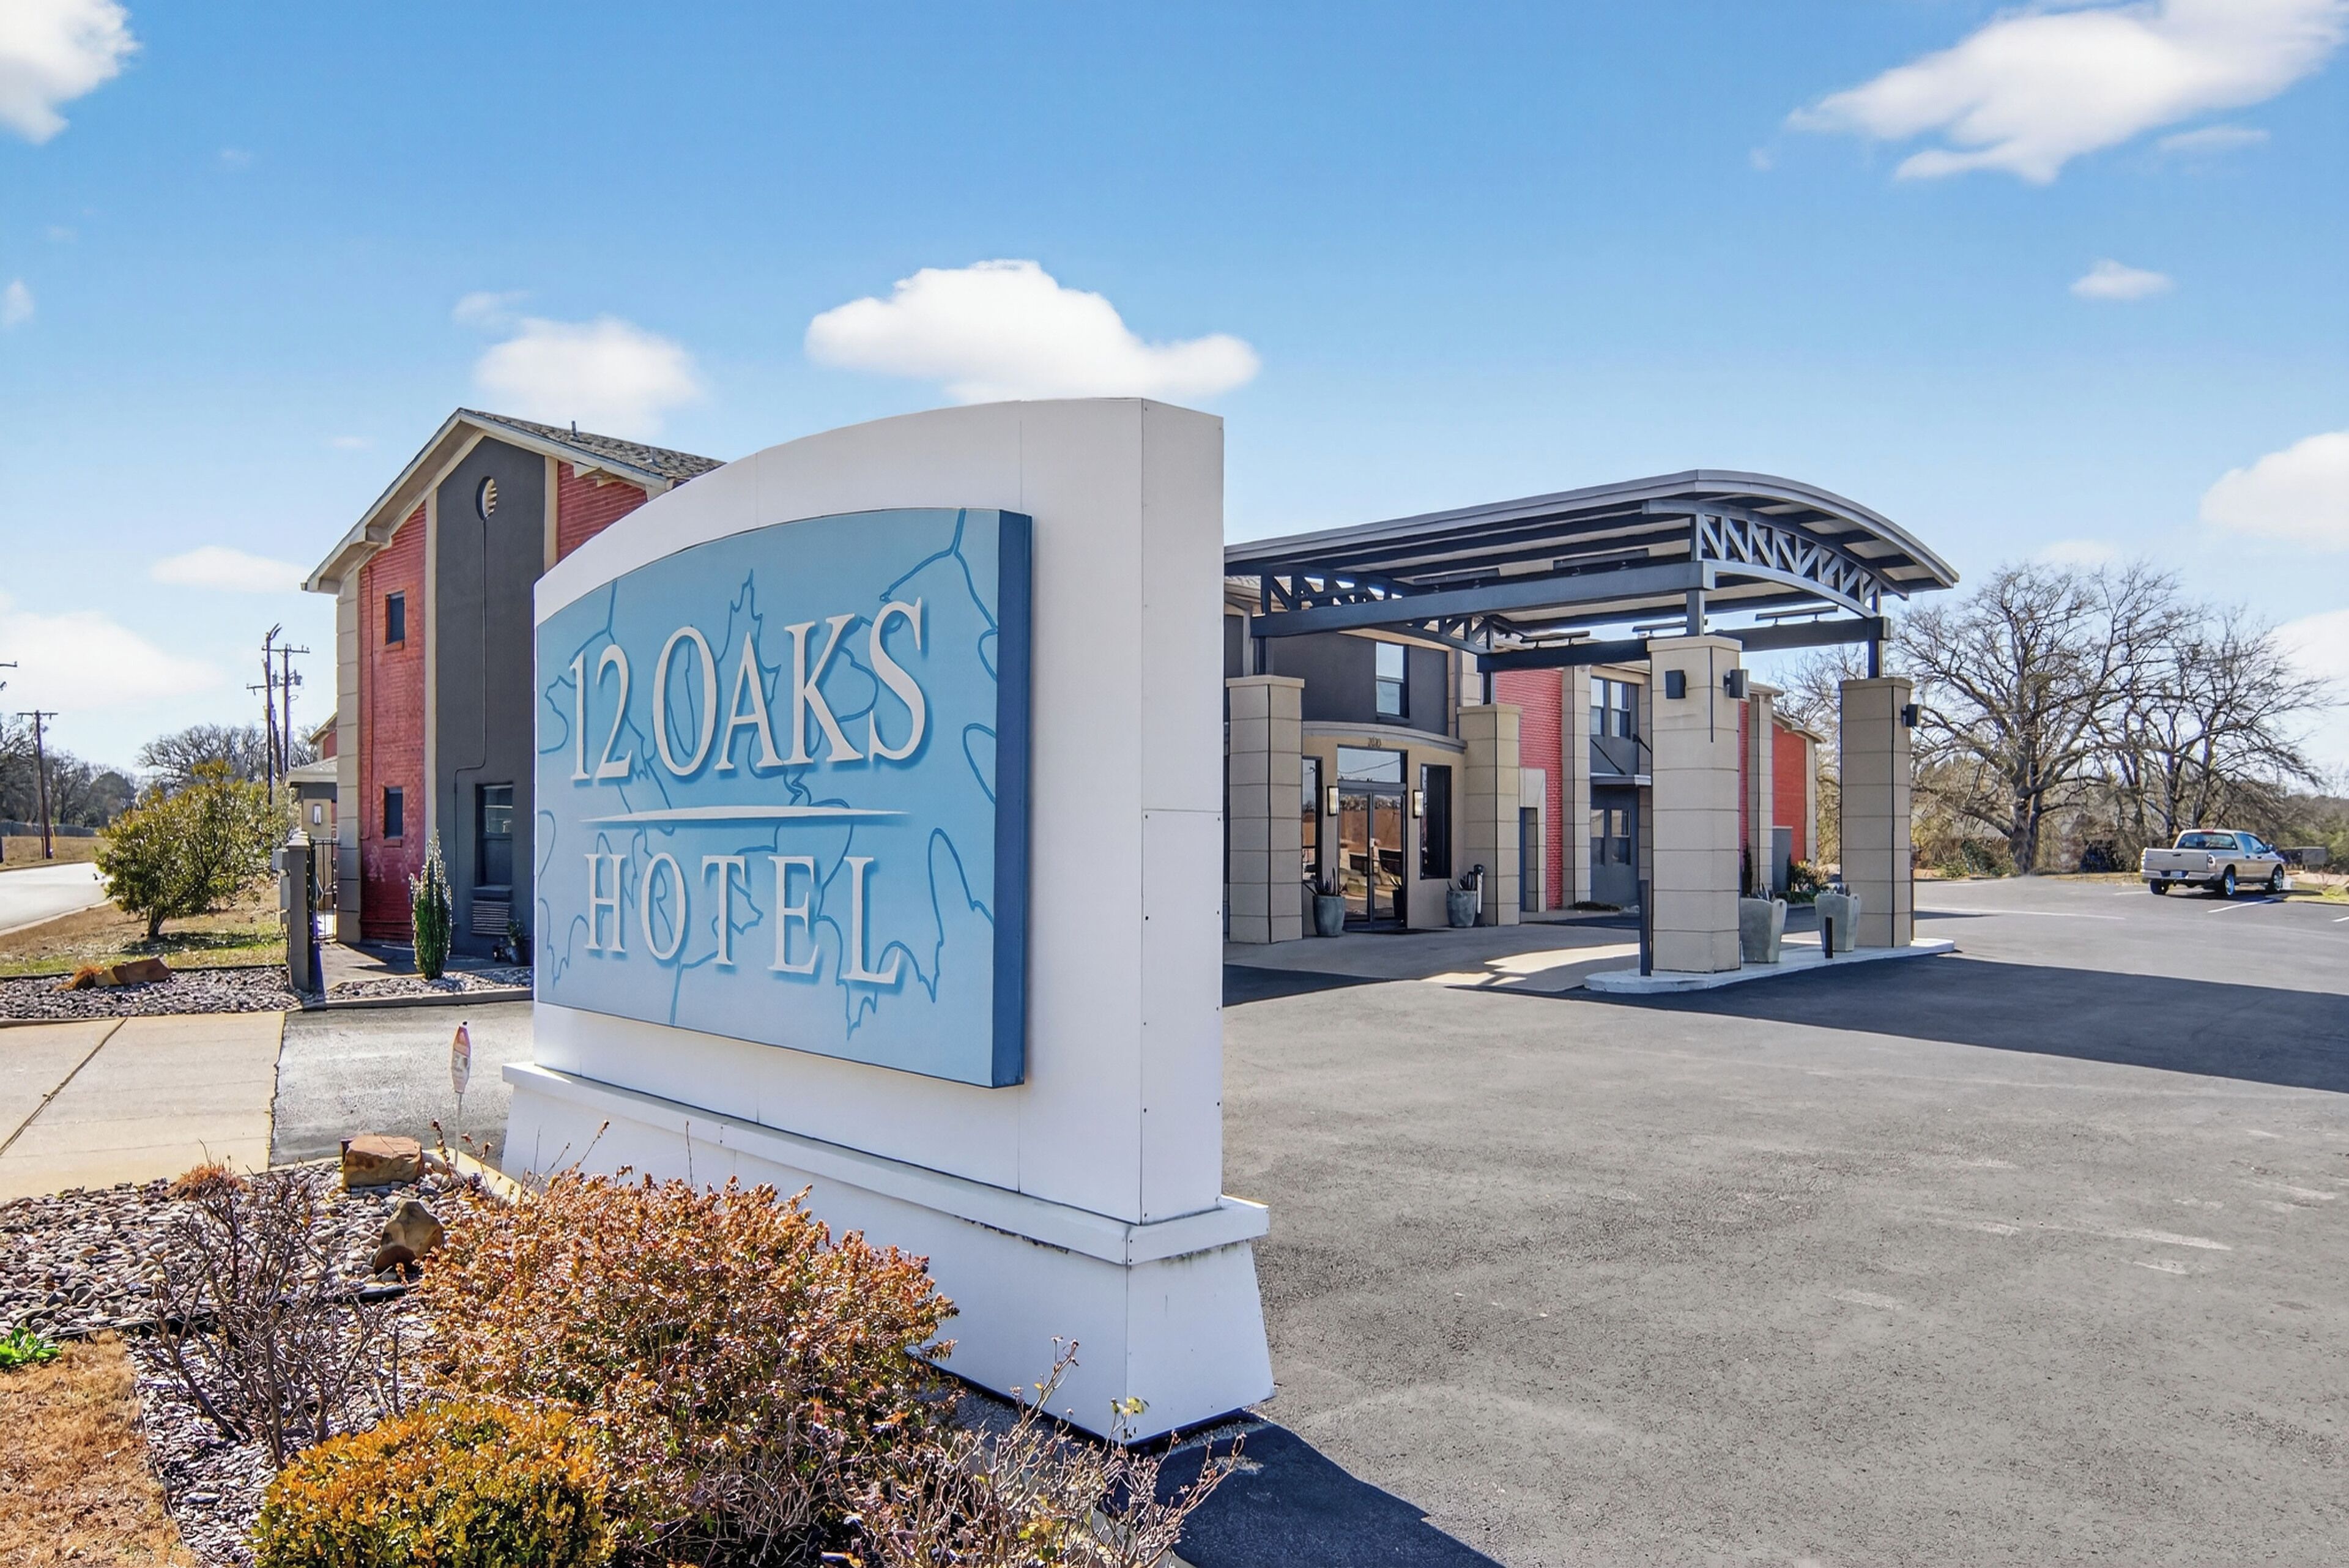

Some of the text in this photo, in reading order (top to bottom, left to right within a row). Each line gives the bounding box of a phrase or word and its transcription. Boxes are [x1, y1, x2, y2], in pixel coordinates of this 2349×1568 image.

[570, 596, 926, 781] 12 OAKS
[584, 853, 901, 984] HOTEL
